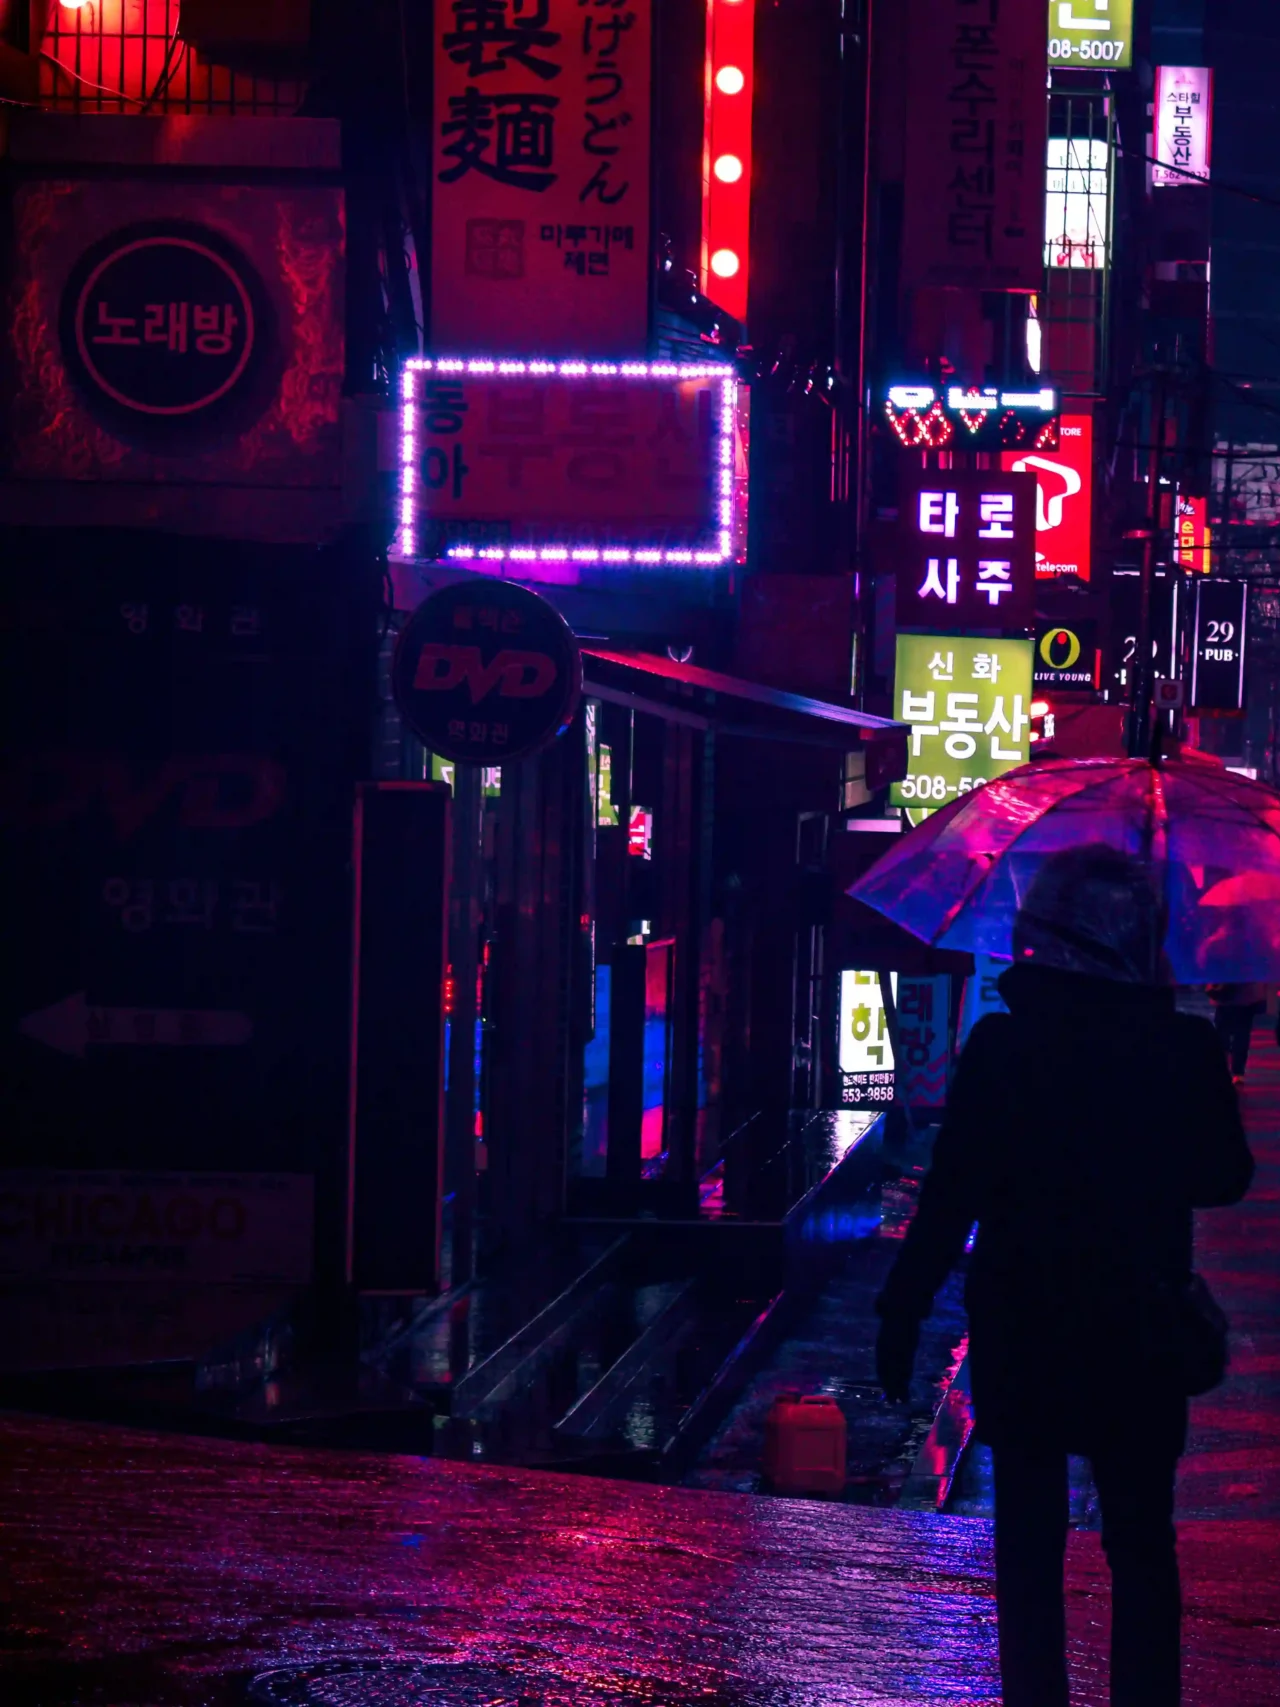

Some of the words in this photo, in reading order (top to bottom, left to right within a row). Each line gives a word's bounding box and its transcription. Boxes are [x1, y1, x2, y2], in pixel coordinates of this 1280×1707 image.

[1048, 38, 1125, 61] 08-5007
[574, 0, 638, 205] げうどん
[1172, 105, 1194, 167] 부동산
[92, 301, 238, 355] 노래방
[1060, 427, 1082, 437] TORE
[917, 490, 1015, 540] 타로
[917, 557, 1014, 606] 사주
[1035, 562, 1078, 573] telecom
[1205, 621, 1235, 643] 29
[413, 643, 558, 706] DVD
[927, 651, 1002, 684] 신화
[1204, 648, 1233, 662] PUB
[1034, 673, 1056, 681] LIVE
[1059, 673, 1092, 683] YOUNG
[901, 689, 1028, 761] 부동산
